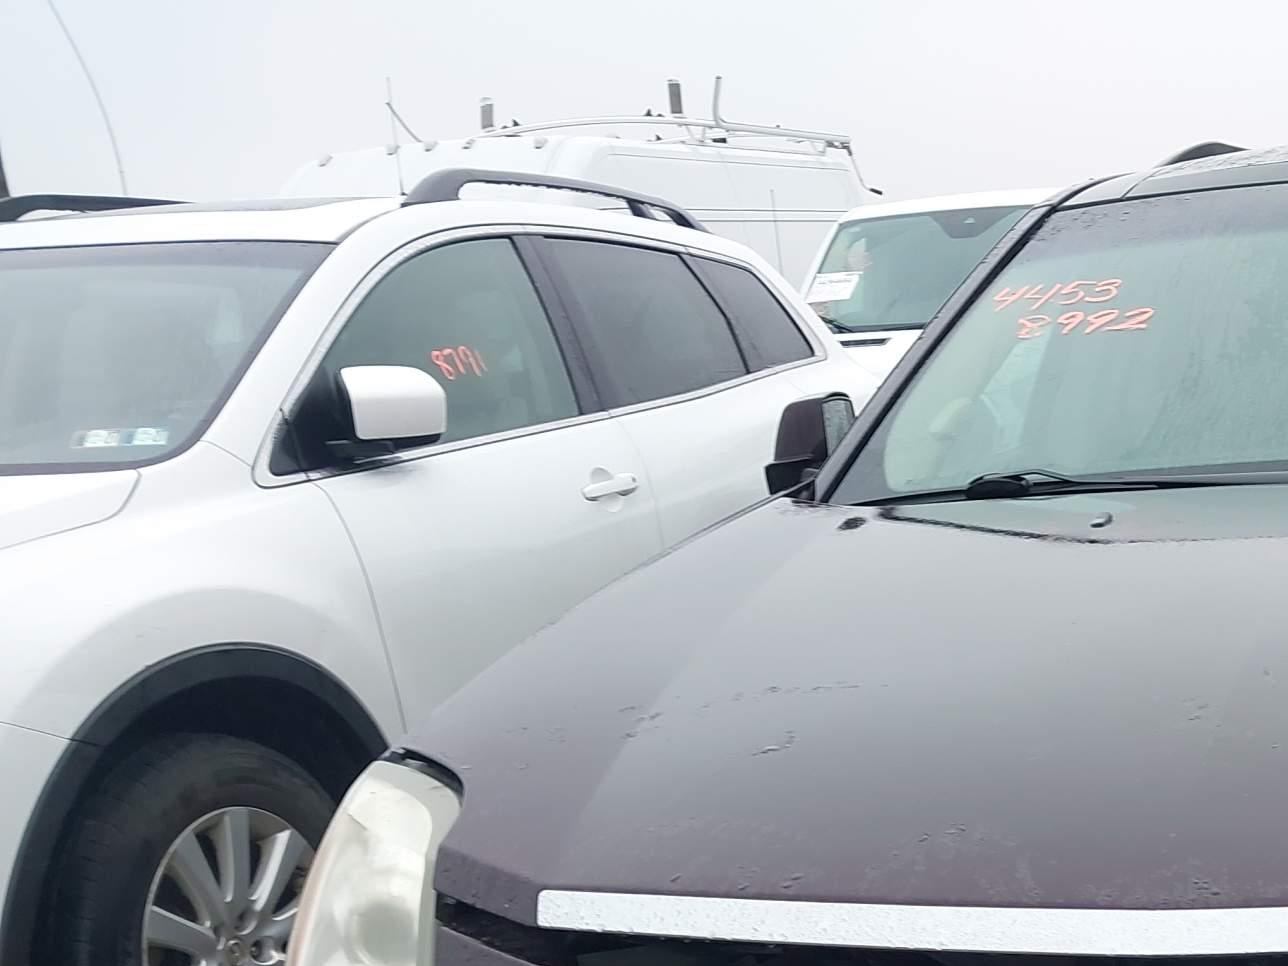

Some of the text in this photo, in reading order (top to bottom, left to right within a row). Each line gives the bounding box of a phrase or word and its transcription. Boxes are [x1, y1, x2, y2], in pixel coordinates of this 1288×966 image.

[992, 278, 1123, 312] 4453
[1015, 307, 1155, 339] 8992
[430, 345, 489, 381] 8791
